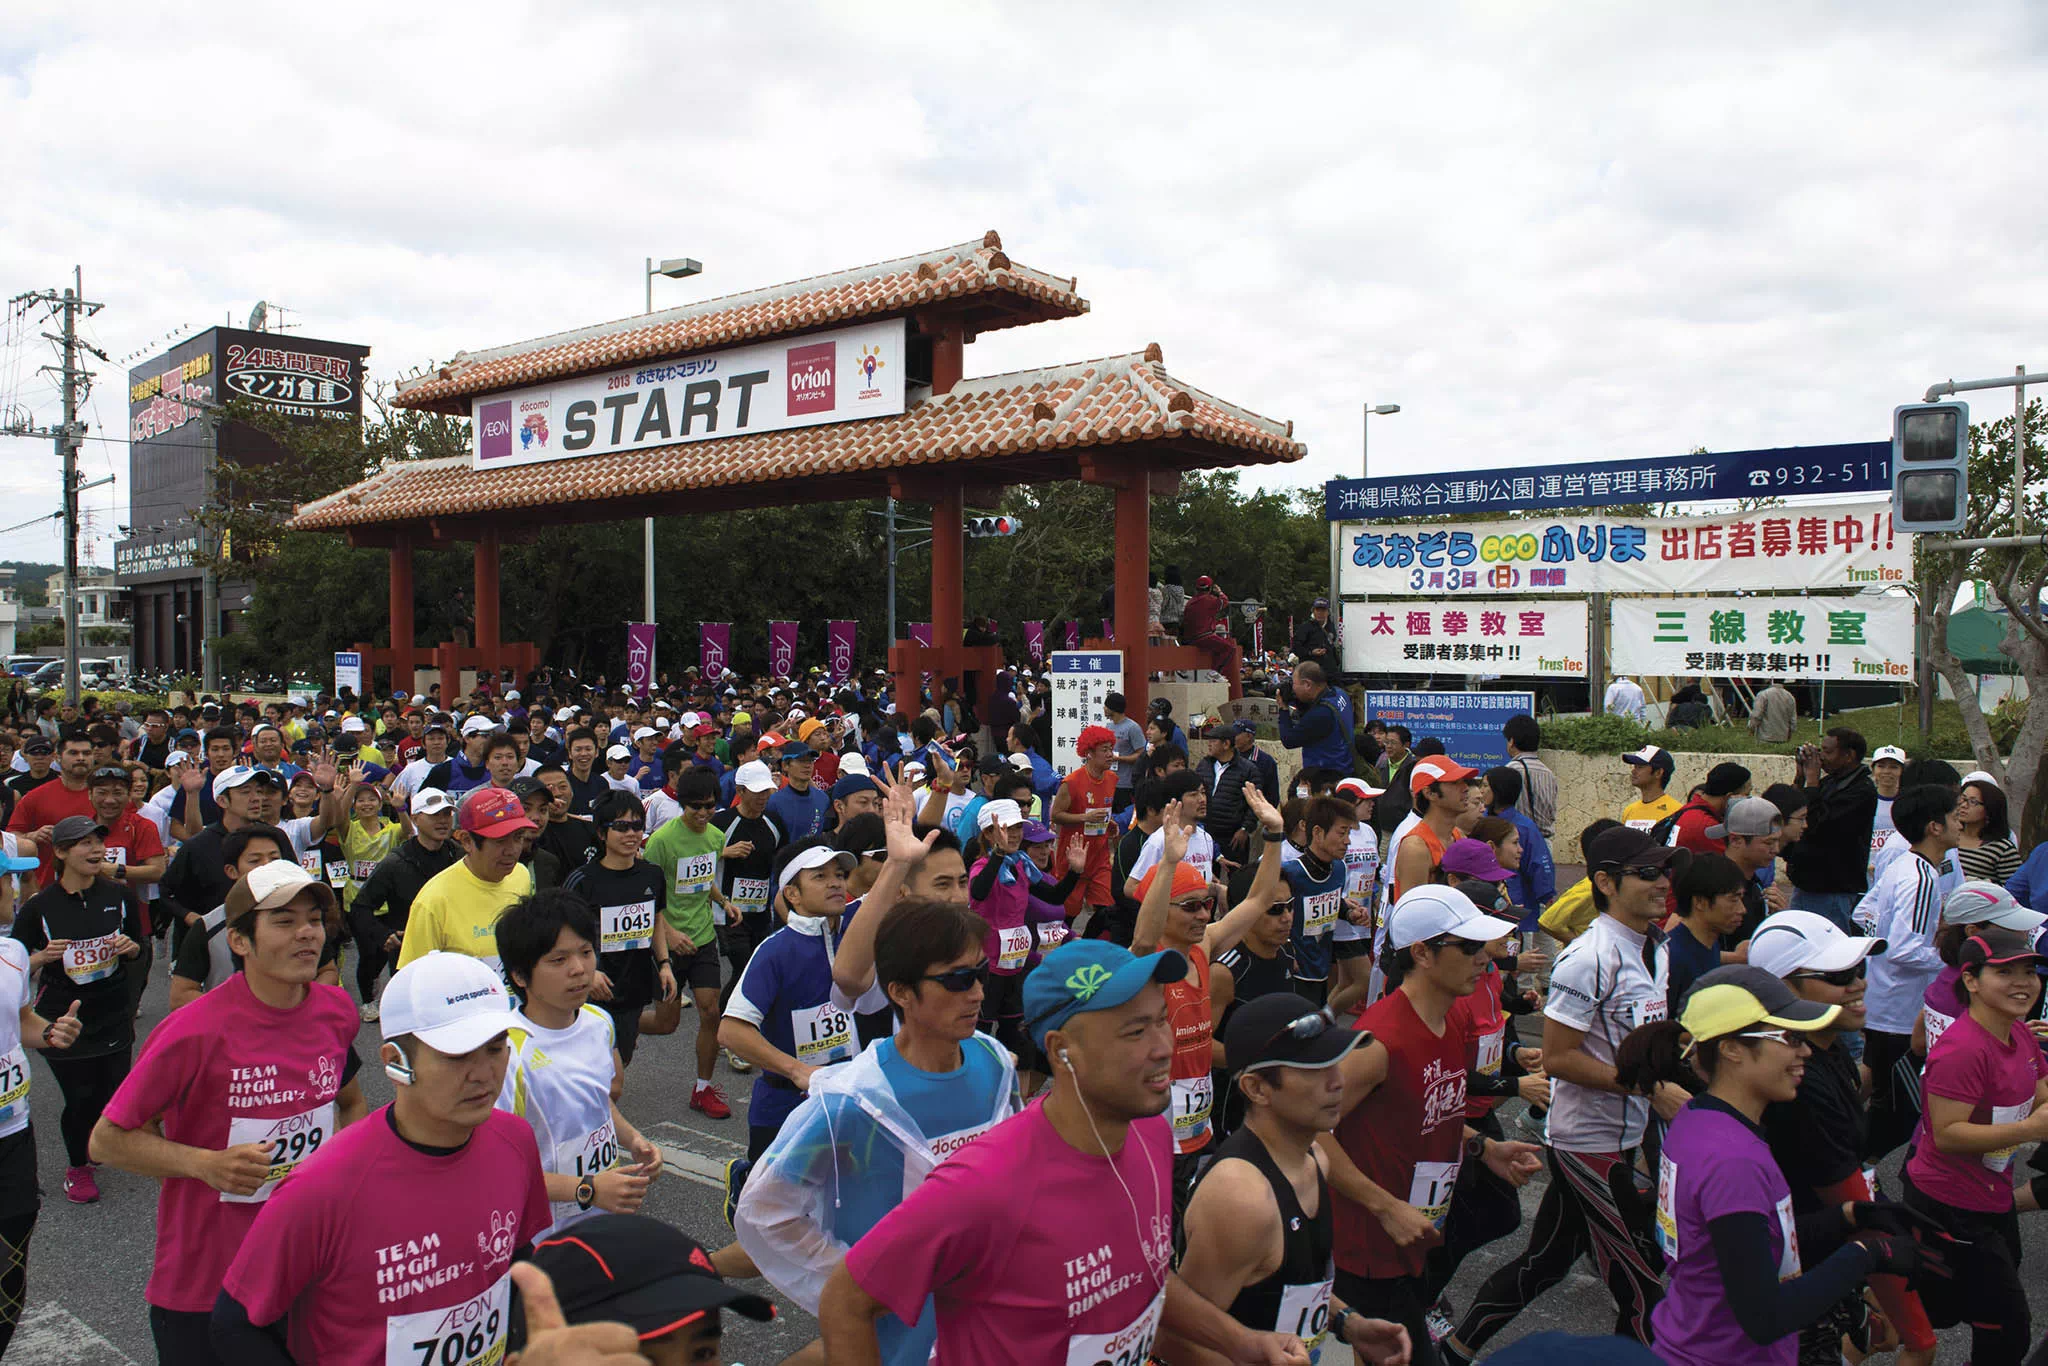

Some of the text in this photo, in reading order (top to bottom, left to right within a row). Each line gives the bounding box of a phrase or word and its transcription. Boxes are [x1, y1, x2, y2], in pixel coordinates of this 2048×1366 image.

[227, 345, 351, 384] 24時間買取
[608, 358, 717, 390] 2013 おきなわマラソン
[238, 374, 336, 403] マンガ倉庫
[519, 399, 550, 412] docomo
[562, 369, 770, 451] START
[1338, 477, 1534, 511] 沖縄県総合運動公園
[1538, 463, 1718, 499] 運営管理事務所
[1370, 610, 1546, 637] 太極拳教室
[1653, 609, 1867, 646] 三線教室
[1068, 657, 1102, 671] 主催
[686, 862, 713, 878] 1393
[613, 912, 651, 933] 1045
[1311, 901, 1338, 919] 5114
[1007, 936, 1030, 952] 7086
[455, 992, 470, 1003] coq
[1551, 980, 1591, 1002] SHIMANO
[810, 1012, 850, 1041] 138
[230, 1064, 278, 1081] TEAM
[259, 1126, 323, 1166] 299
[375, 1232, 440, 1266] TEAM
[1063, 1244, 1113, 1279] TEAM
[413, 1308, 500, 1366] 7069
